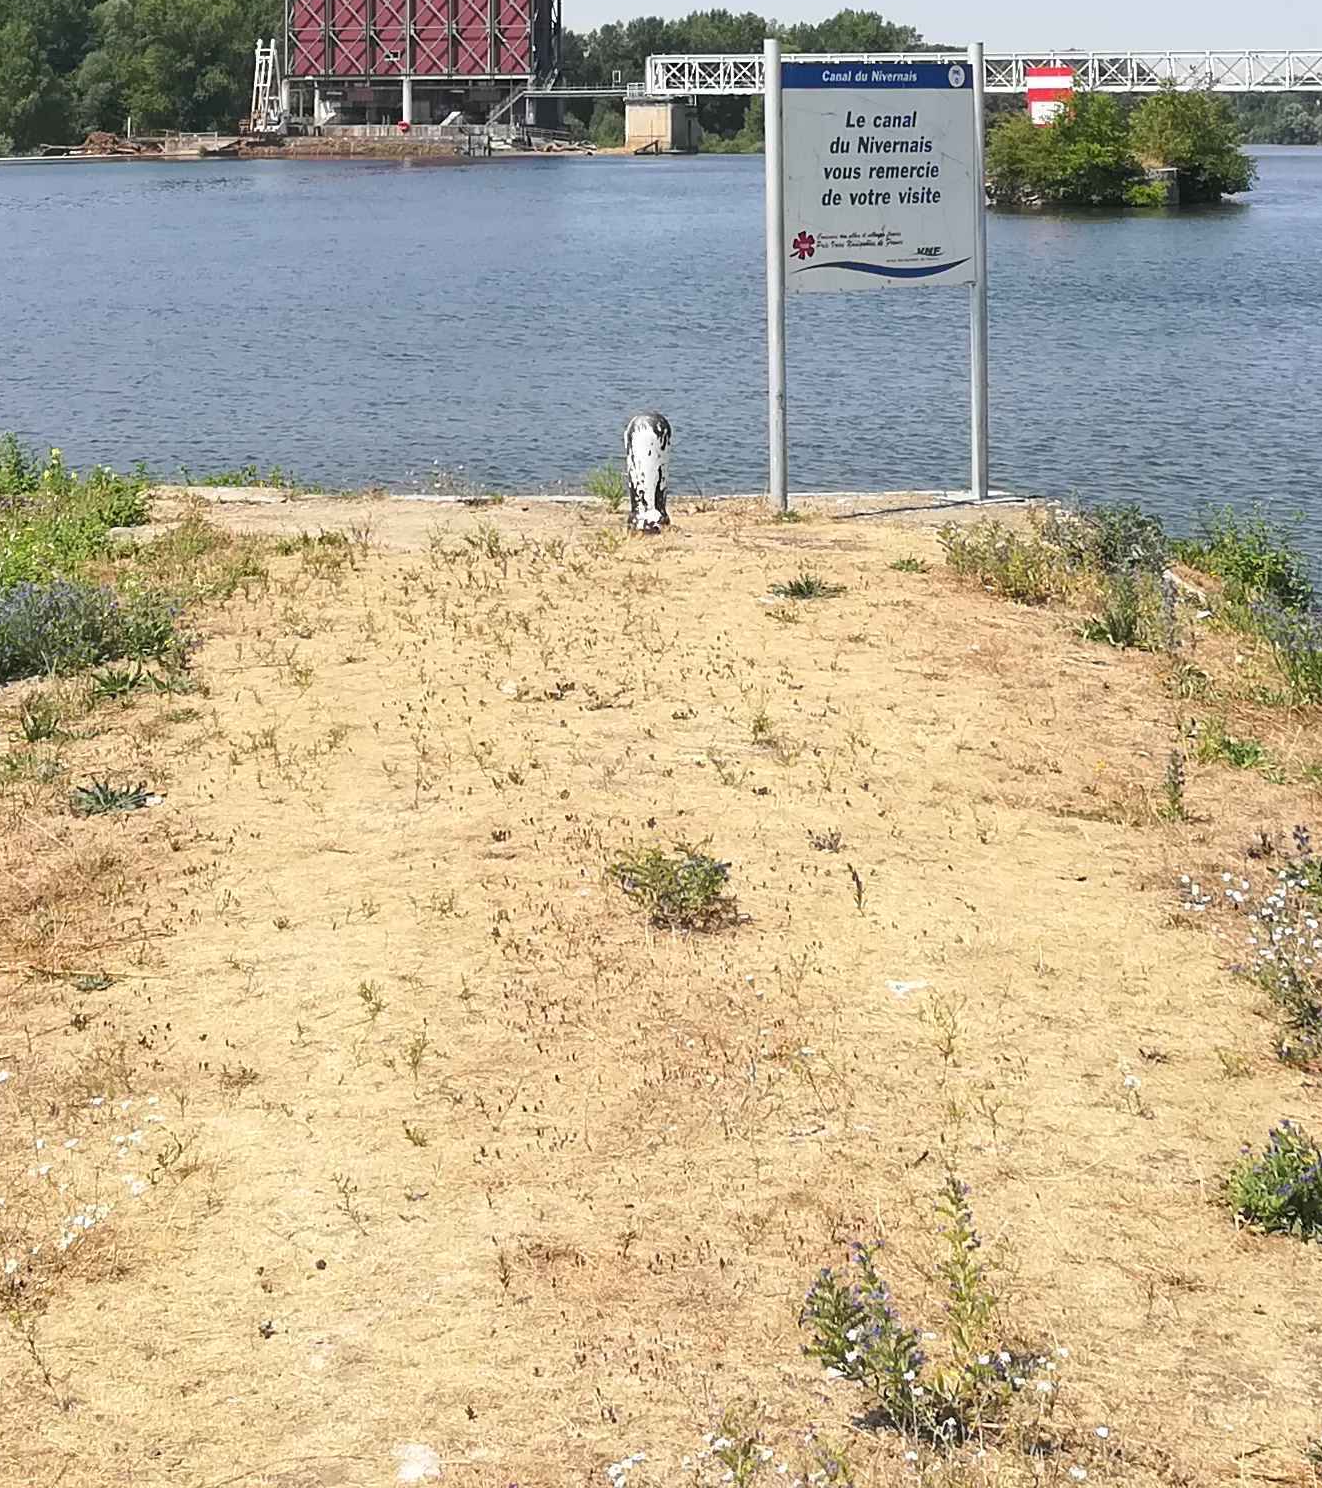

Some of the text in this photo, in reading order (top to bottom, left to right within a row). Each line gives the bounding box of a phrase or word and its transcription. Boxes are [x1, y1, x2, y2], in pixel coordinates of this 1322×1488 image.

[821, 69, 918, 83] Canal du Nivernais
[845, 110, 918, 128] Le canal
[829, 136, 933, 154] du Nivernais
[823, 162, 940, 180] vous remercie
[821, 186, 942, 207] de votre visite
